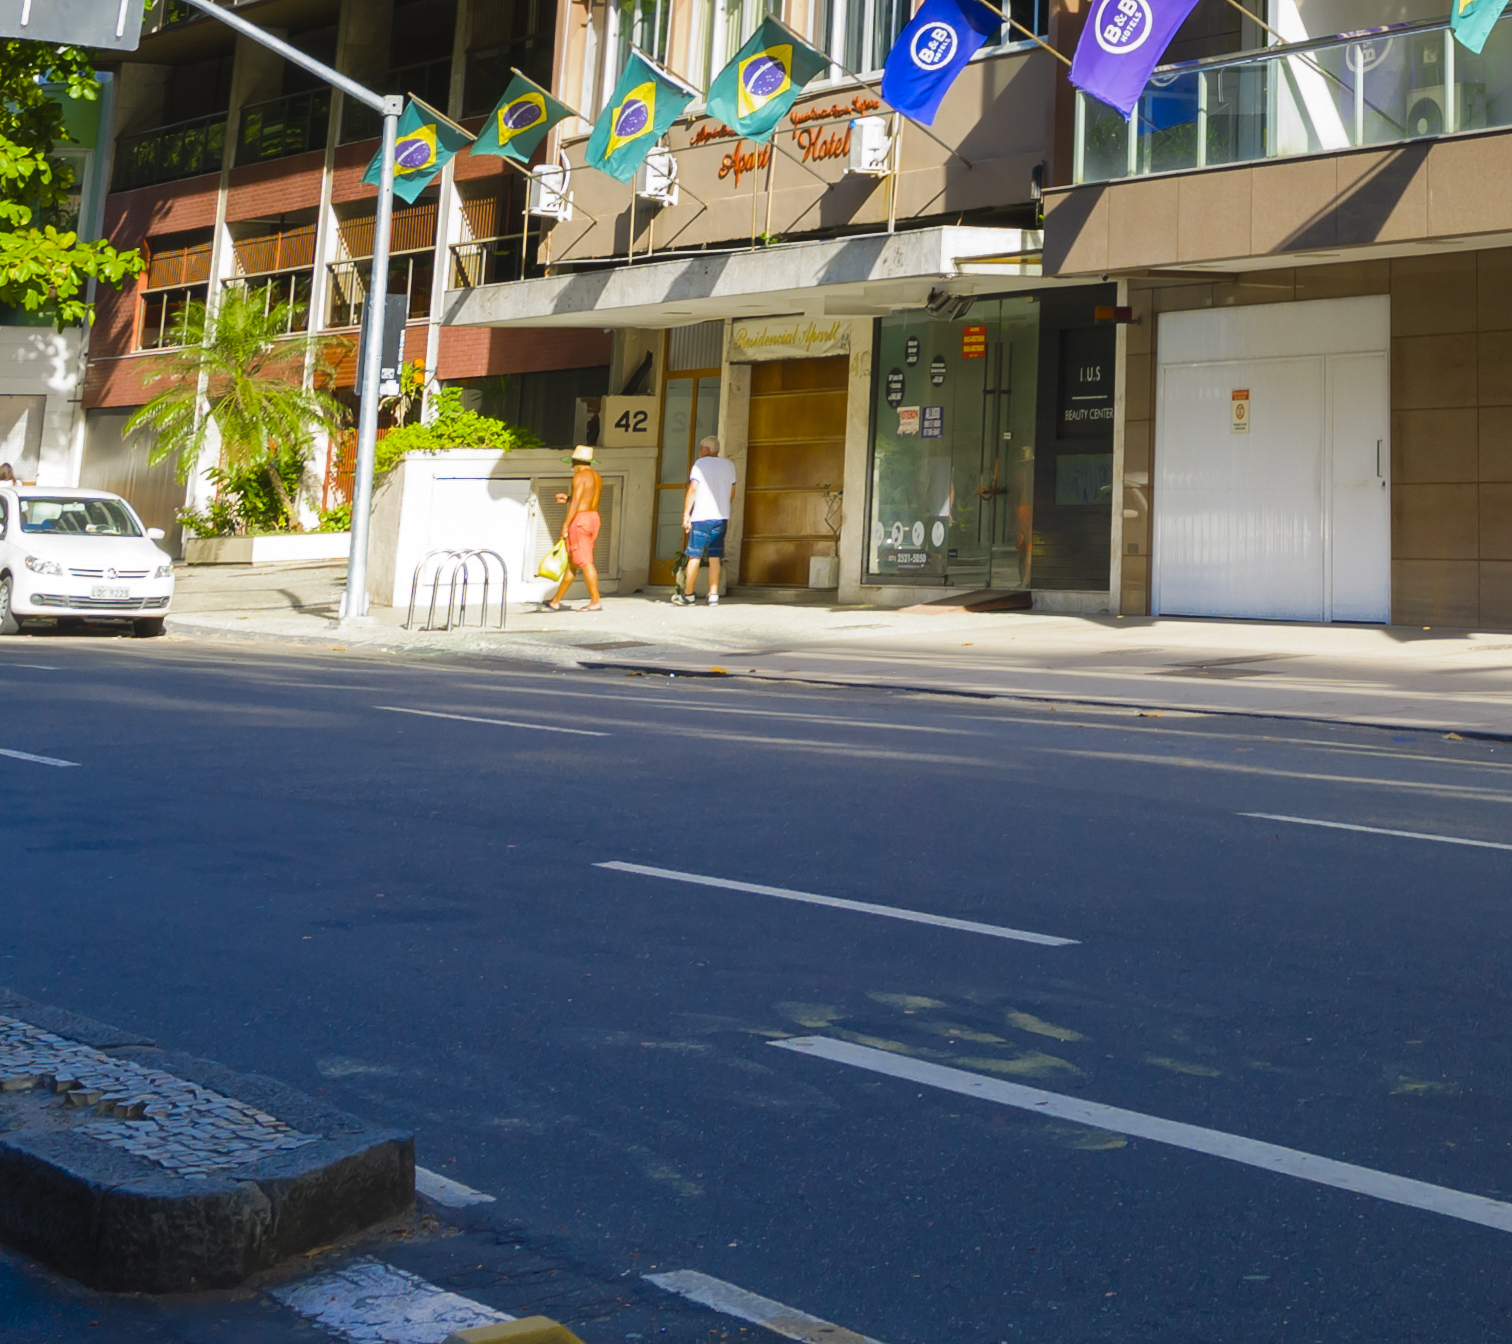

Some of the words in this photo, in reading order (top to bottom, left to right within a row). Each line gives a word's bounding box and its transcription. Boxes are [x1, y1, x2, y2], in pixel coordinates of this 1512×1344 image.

[1122, 11, 1143, 43] HOTELS
[918, 28, 948, 64] B&B
[933, 37, 952, 63] HOTELS
[718, 140, 771, 189] Apart
[797, 125, 851, 163] Hotel
[614, 410, 648, 433] 42
[1064, 409, 1088, 421] BEAUTY
[1089, 407, 1114, 420] CENTER
